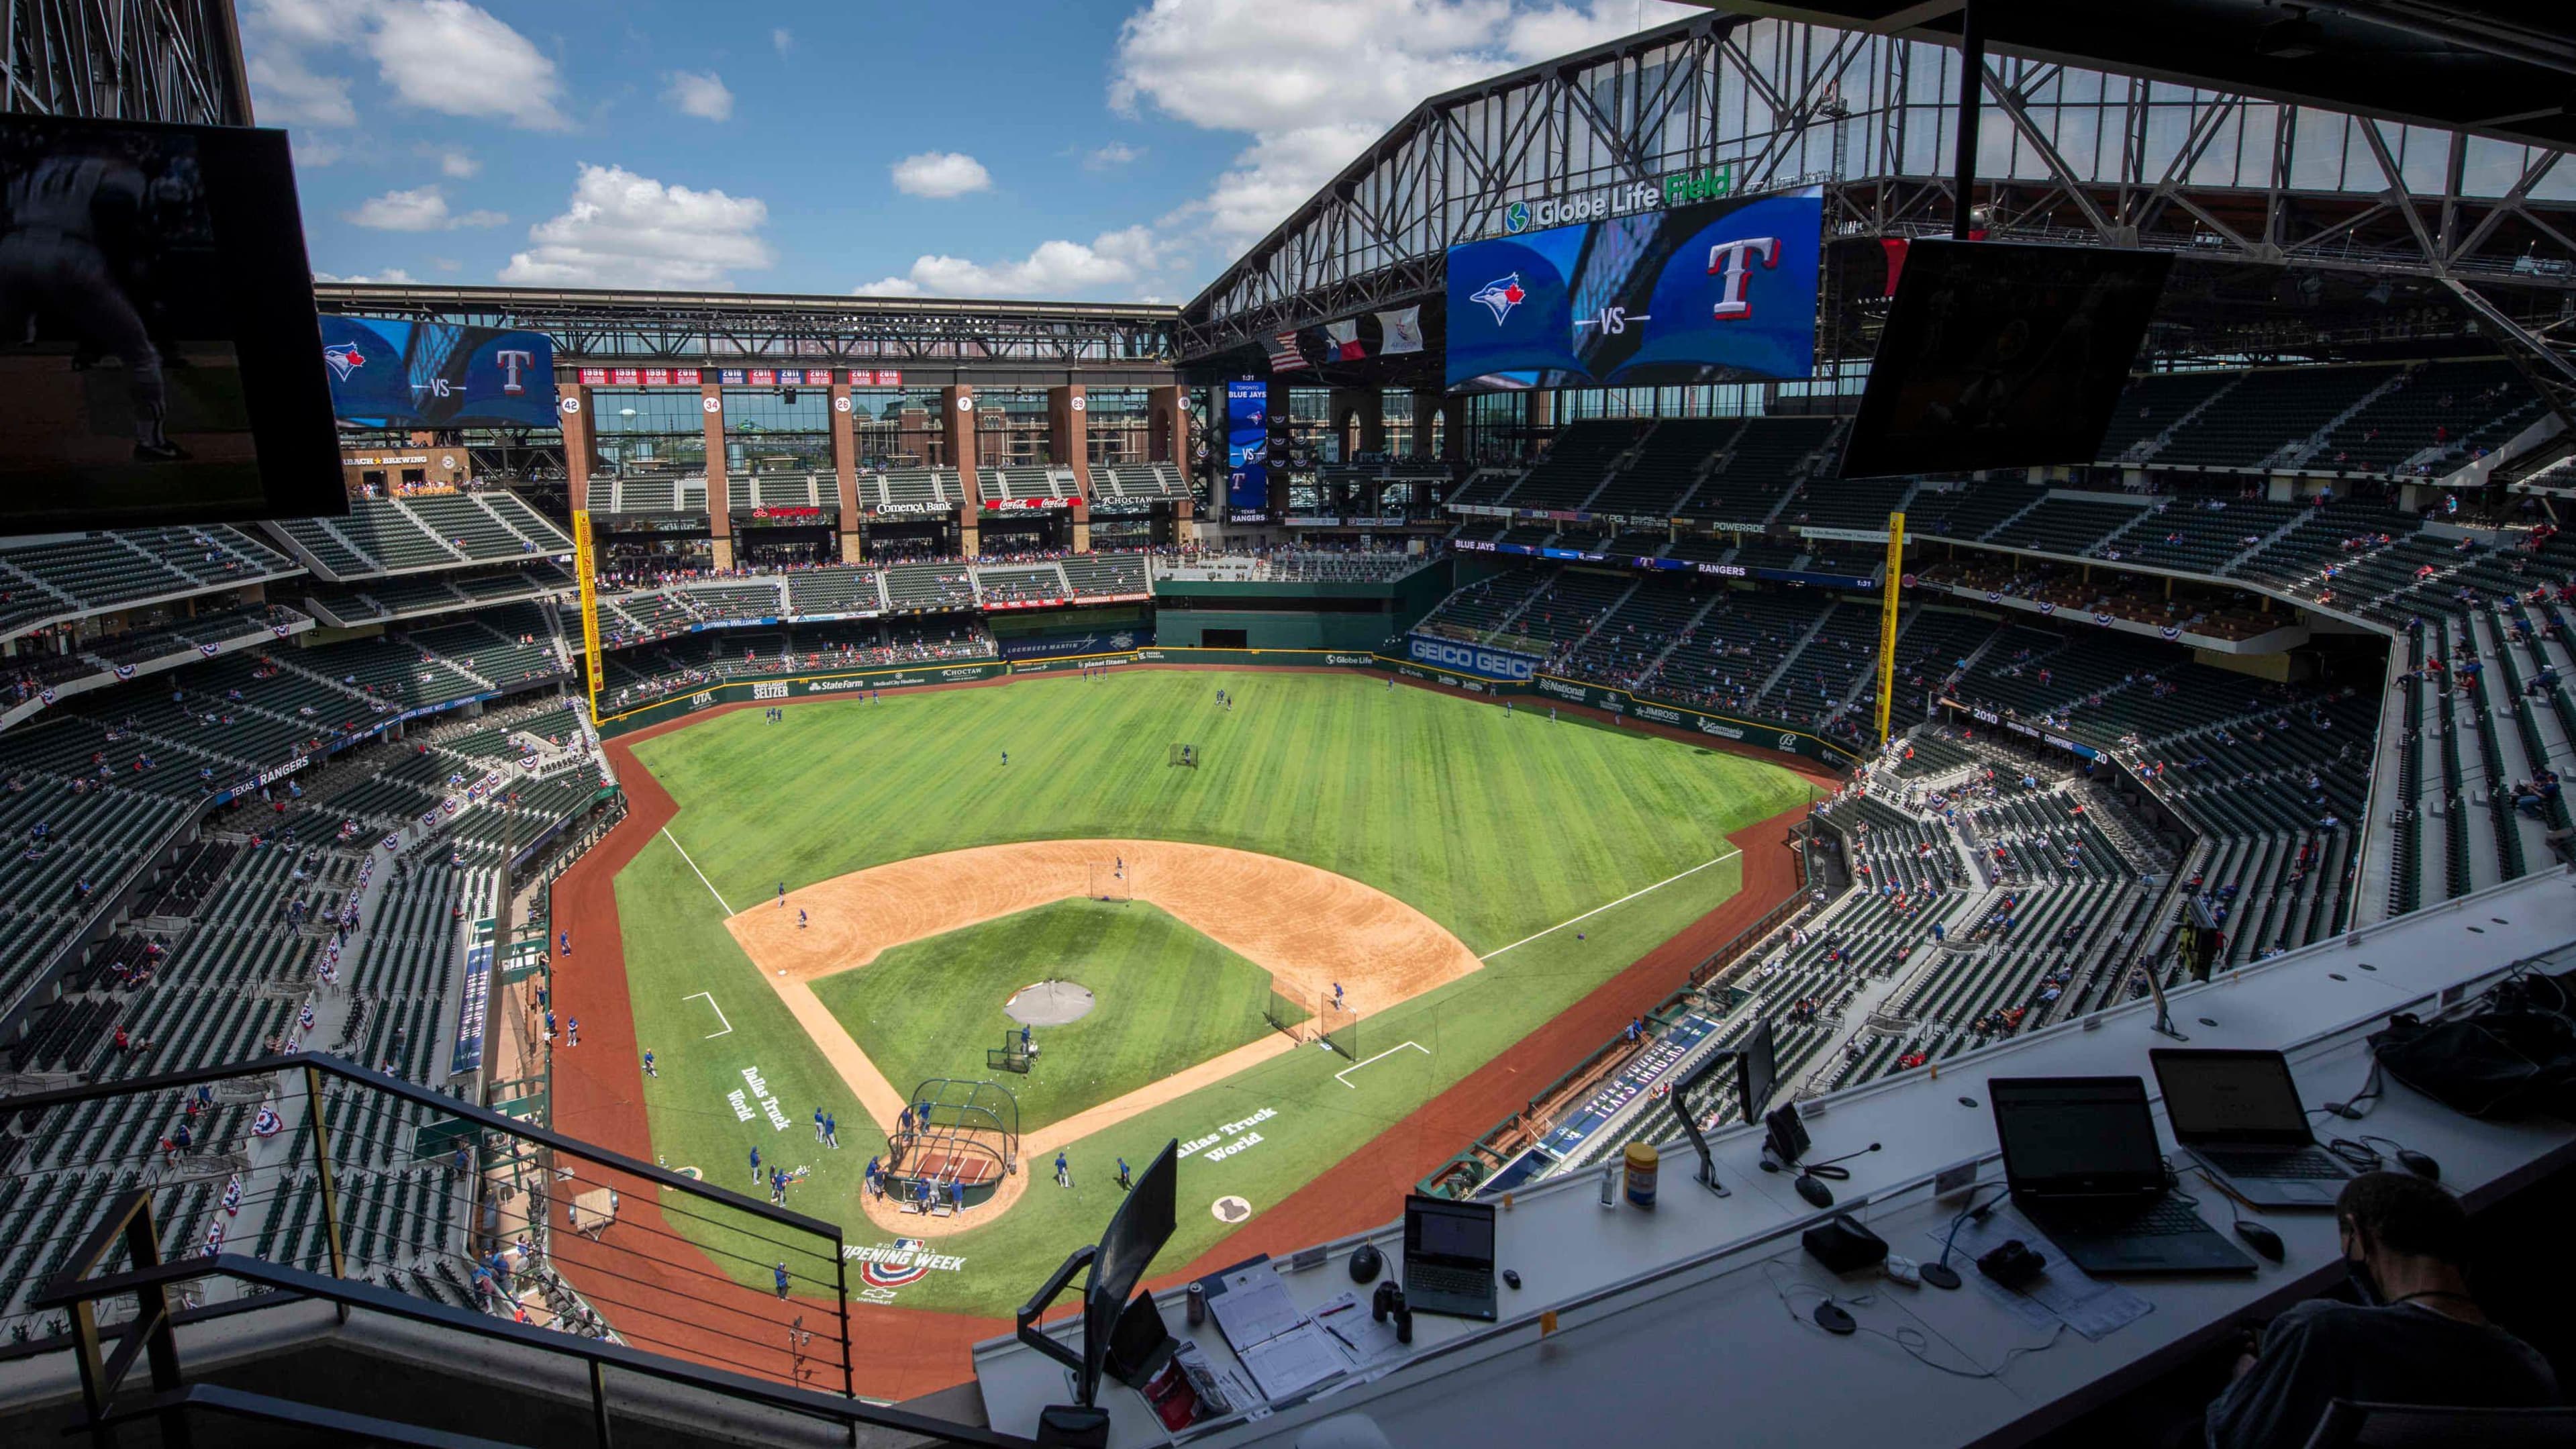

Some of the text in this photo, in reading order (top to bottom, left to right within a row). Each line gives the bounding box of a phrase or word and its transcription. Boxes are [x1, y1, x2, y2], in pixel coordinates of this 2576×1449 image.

[1536, 164, 1731, 226] Globe Life Field
[1601, 307, 1625, 335] VS
[583, 368, 604, 377] 1996
[646, 368, 667, 377] 1999
[677, 368, 697, 377] 2010
[430, 378, 450, 397] VS
[564, 401, 578, 409] 42
[705, 401, 718, 409] 34
[838, 401, 848, 409] 26
[962, 399, 969, 409] 7
[1074, 399, 1084, 409] 29
[382, 456, 428, 464] BREWING
[1242, 448, 1254, 461] VS
[927, 501, 952, 511] Bank
[1107, 495, 1154, 505] CHOCTAW
[1231, 514, 1266, 523] RANGERS
[1713, 521, 1767, 534] POWERADE
[581, 525, 592, 577] BRING
[1455, 540, 1495, 552] BLUE JAYS
[1698, 564, 1746, 577] RANGERS
[585, 579, 595, 609] THE
[589, 611, 599, 652] HEAT
[1007, 642, 1079, 654] LOCKHEED MARTIN
[1411, 640, 1473, 667] GEICO
[1084, 660, 1105, 669] planet
[1105, 658, 1128, 666] fitness
[942, 668, 982, 677] CHOCTAW
[754, 685, 789, 700] SELTZER
[1550, 681, 1586, 697] National
[693, 691, 712, 705] UTA
[1710, 722, 1744, 736] Germania
[1974, 708, 1999, 725] 2010
[2044, 733, 2073, 750] CHAMPIONS
[2095, 749, 2108, 765] 20
[230, 755, 309, 797] TEXAS RANGERS
[727, 1088, 756, 1122] World
[741, 1066, 792, 1132] Dallas Truck
[1176, 1107, 1279, 1159] allas Truck
[1203, 1132, 1265, 1162] World
[913, 1251, 968, 1272] WEEK
[856, 1296, 893, 1305] CHEVROLET
